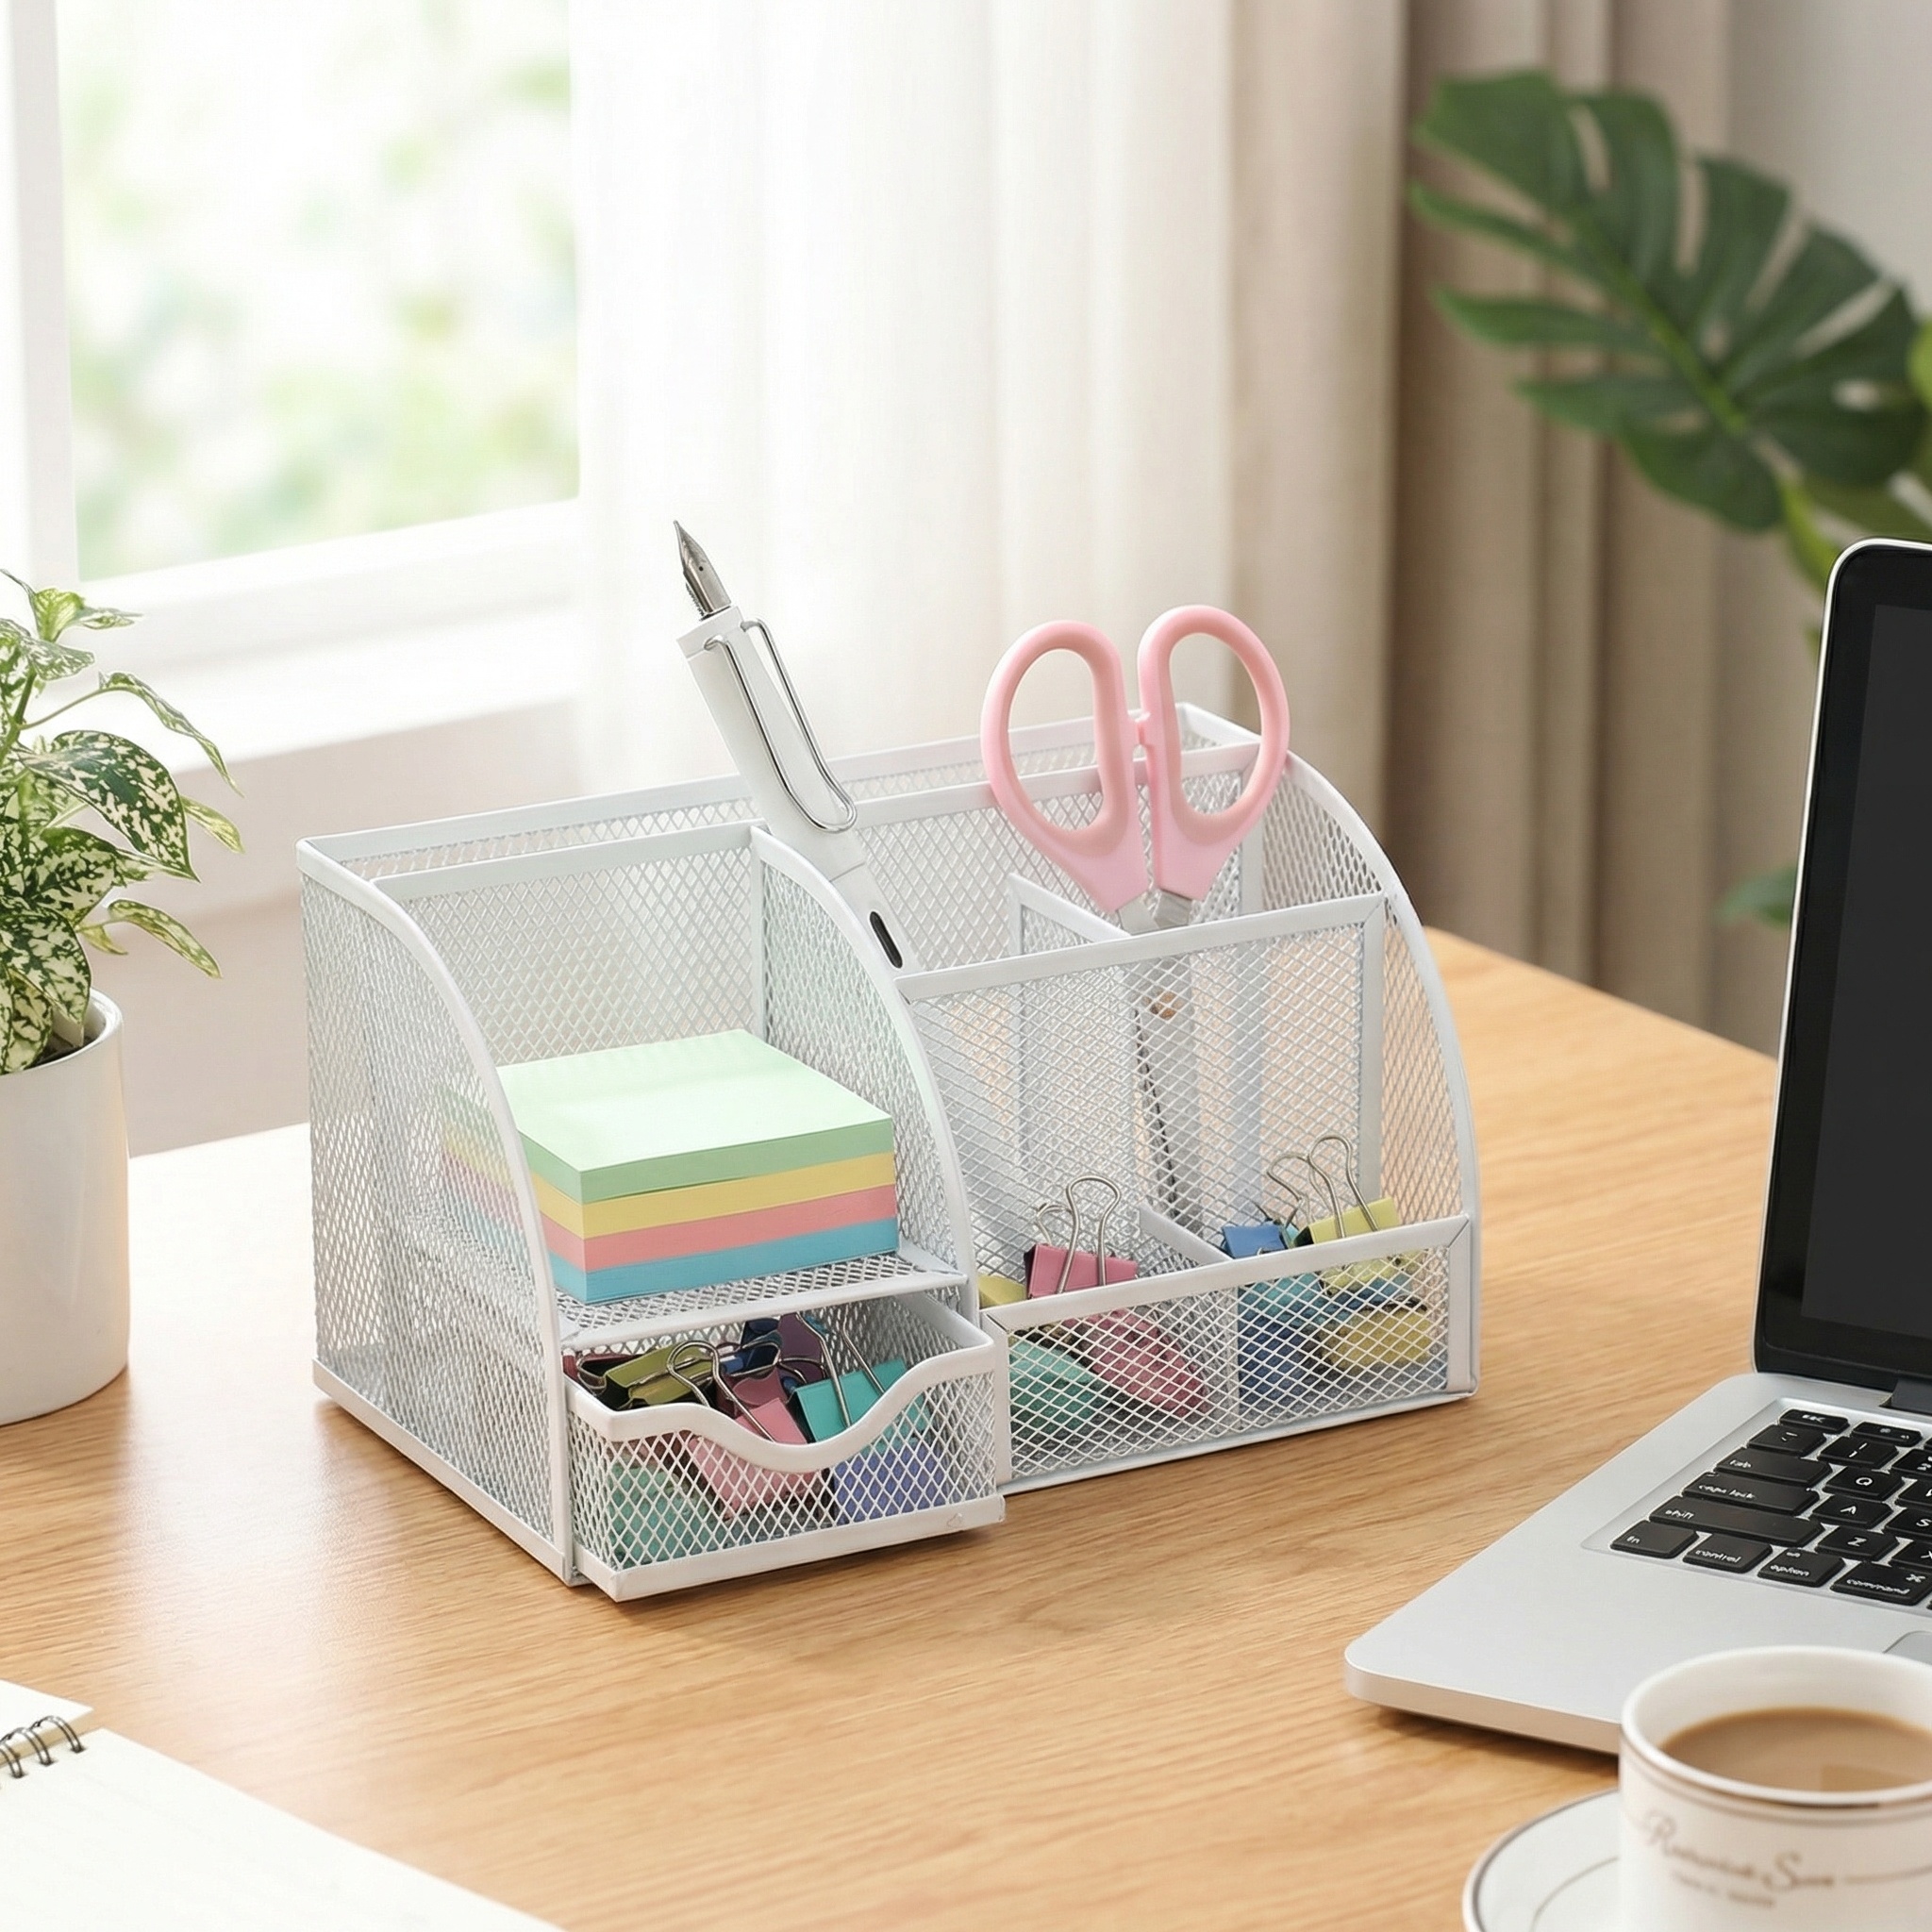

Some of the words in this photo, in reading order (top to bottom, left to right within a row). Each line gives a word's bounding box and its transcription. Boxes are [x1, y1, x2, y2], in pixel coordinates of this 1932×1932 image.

[1856, 1476, 1874, 1487] Q
[1840, 1505, 1857, 1515] A
[1915, 1518, 1932, 1527] S
[1847, 1537, 1868, 1547] Z
